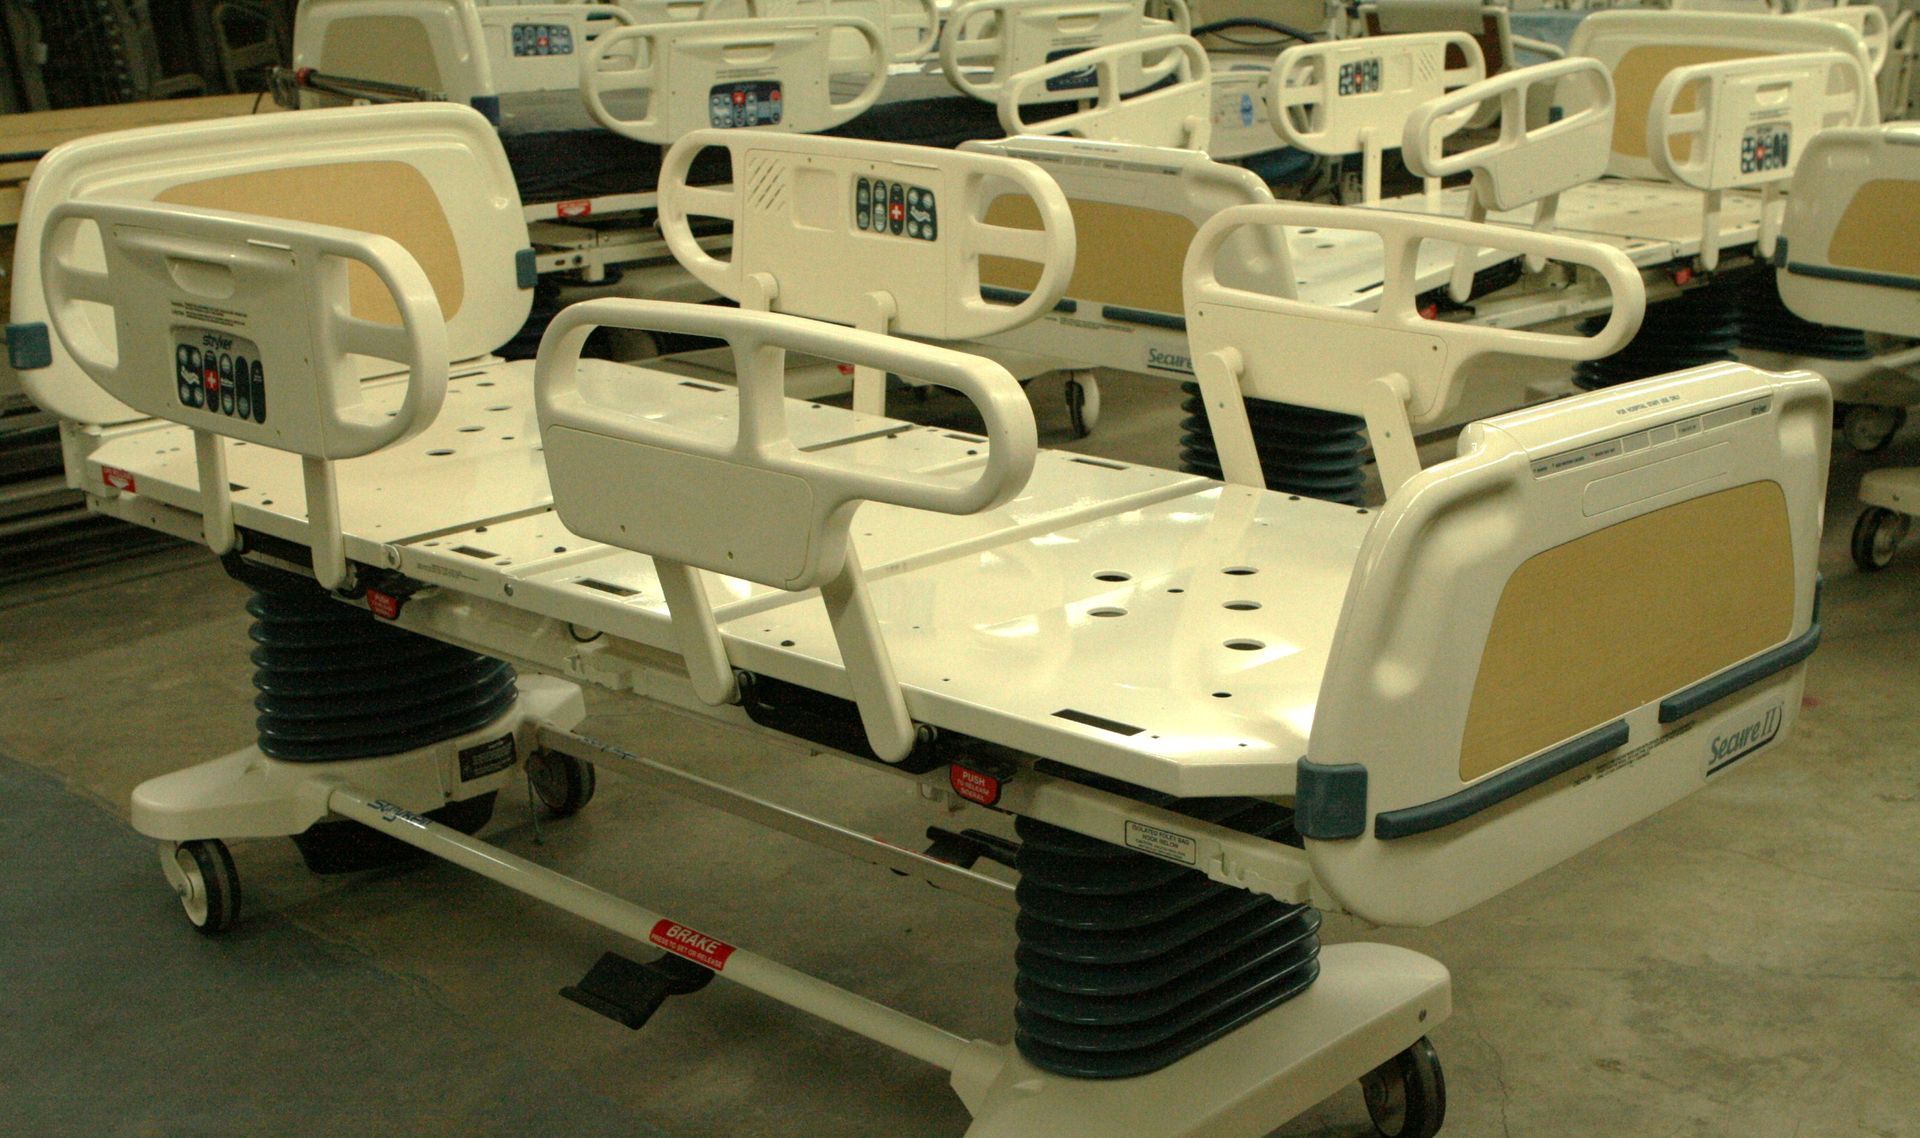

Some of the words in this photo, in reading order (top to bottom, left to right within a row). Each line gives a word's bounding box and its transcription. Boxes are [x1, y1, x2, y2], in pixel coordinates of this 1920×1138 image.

[1708, 721, 1761, 766] Secure
[1761, 706, 1778, 737] II
[962, 771, 985, 787] PUSH
[666, 925, 722, 954] BRAKE
